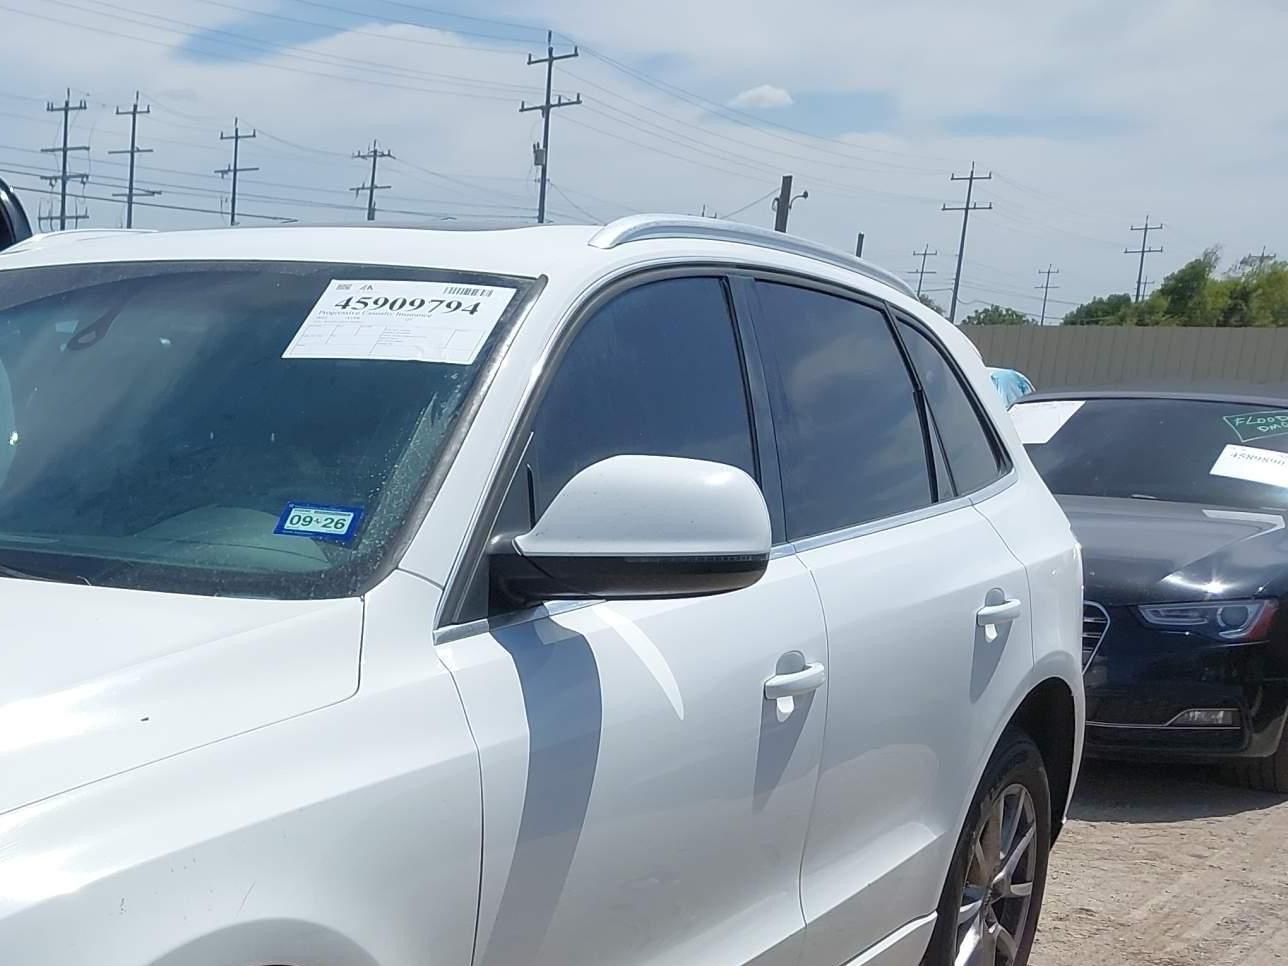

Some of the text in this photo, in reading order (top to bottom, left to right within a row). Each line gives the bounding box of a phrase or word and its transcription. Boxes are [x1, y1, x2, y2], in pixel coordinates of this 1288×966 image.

[334, 295, 482, 316] 45909794
[289, 514, 347, 530] 09 26
